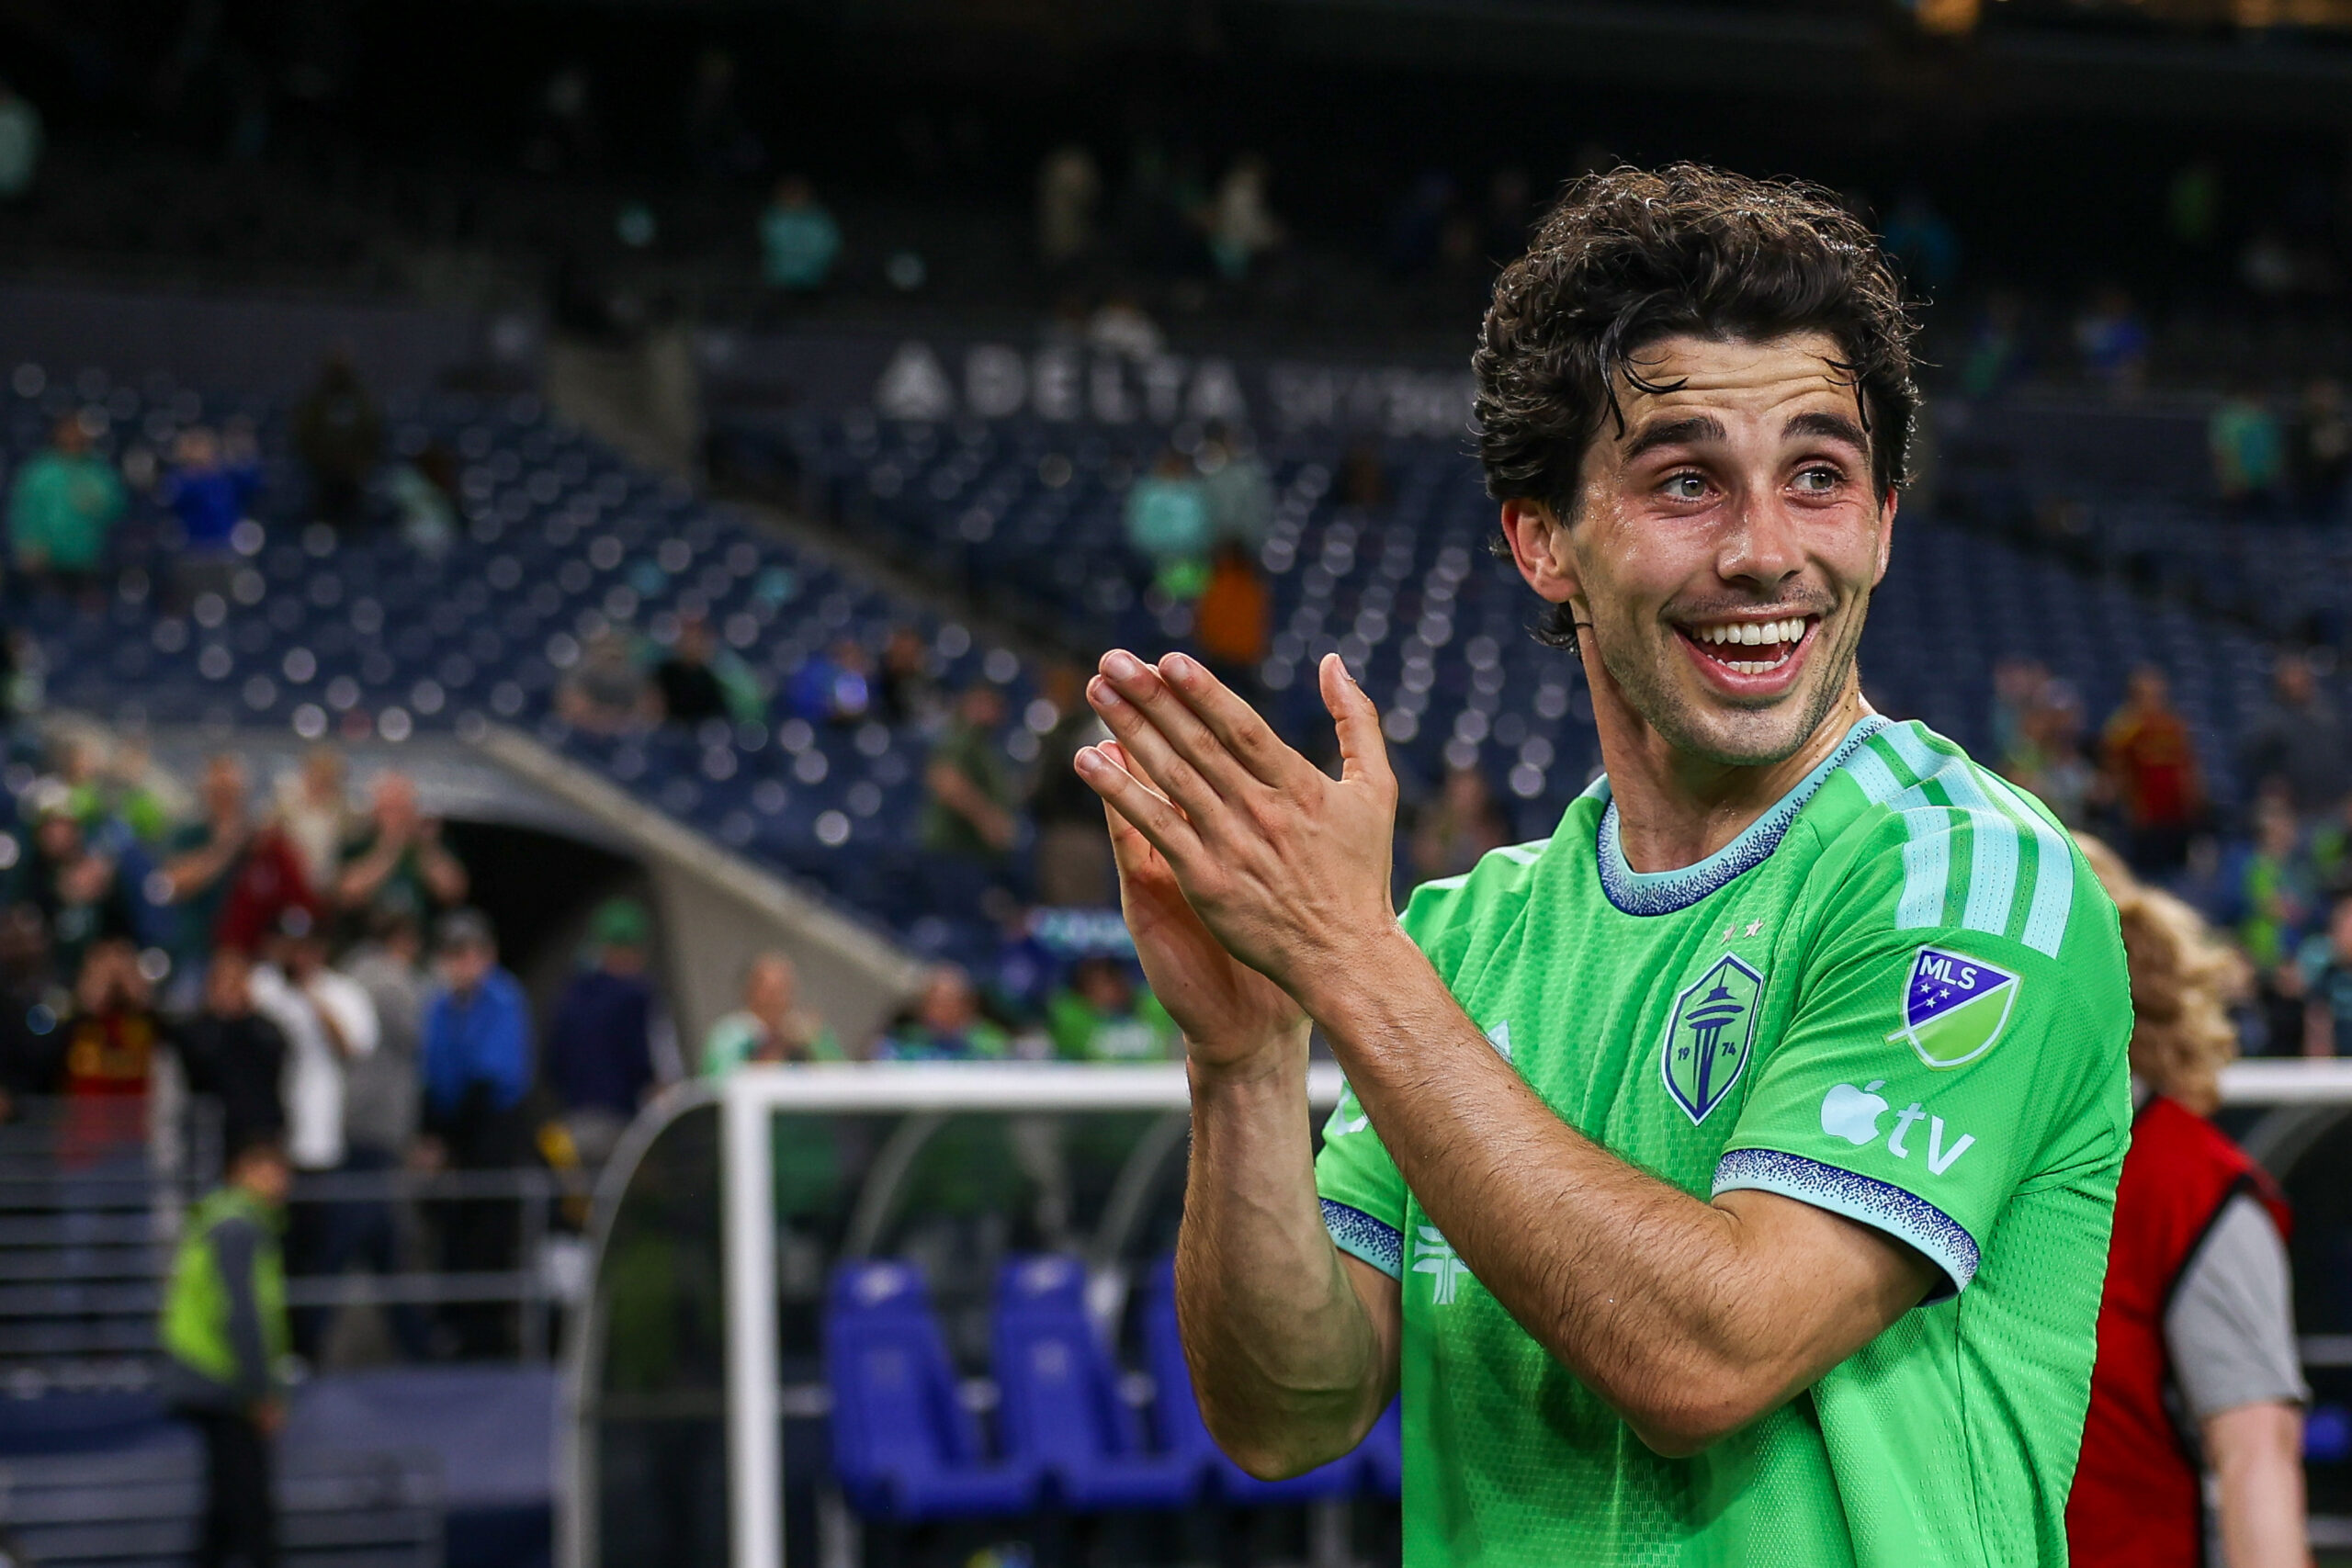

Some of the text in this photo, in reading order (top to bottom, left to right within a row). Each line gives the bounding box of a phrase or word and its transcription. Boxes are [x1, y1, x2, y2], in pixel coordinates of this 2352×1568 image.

[962, 343, 1248, 423] DELTA
[1919, 954, 1977, 990] MLS
[1678, 1042, 1736, 1061] 19 74
[1888, 1102, 1975, 1176] tv
